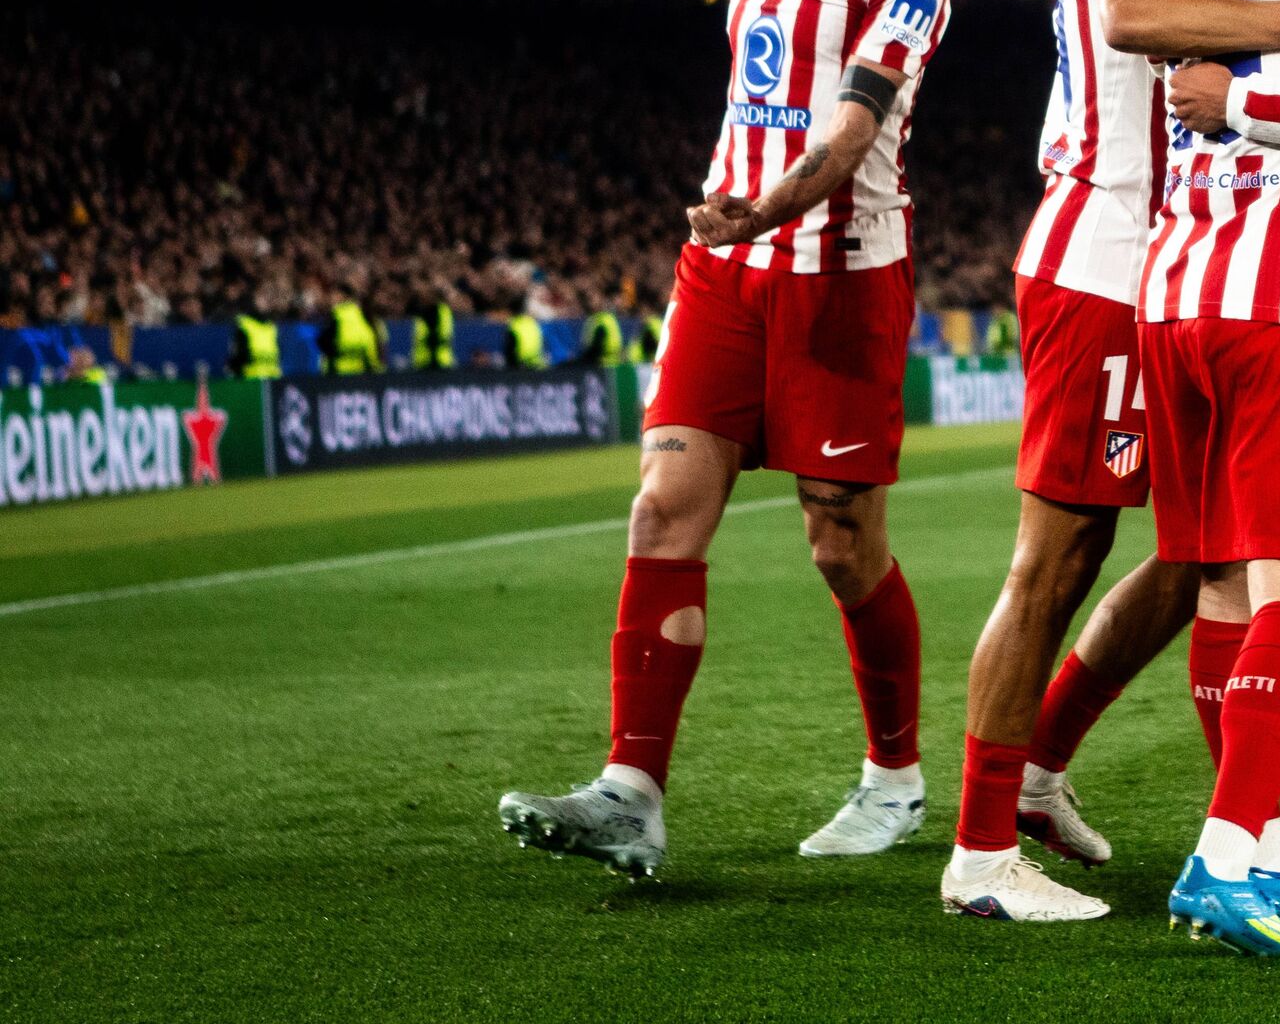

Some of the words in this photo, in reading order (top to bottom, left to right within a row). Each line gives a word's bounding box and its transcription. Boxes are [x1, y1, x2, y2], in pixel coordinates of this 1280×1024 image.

[775, 108, 807, 128] AIR
[1194, 169, 1214, 189] the
[318, 390, 382, 453] UEFA
[382, 386, 510, 447] CHAMPIONS
[0, 378, 182, 506] eineken
[1194, 684, 1225, 702] ATL
